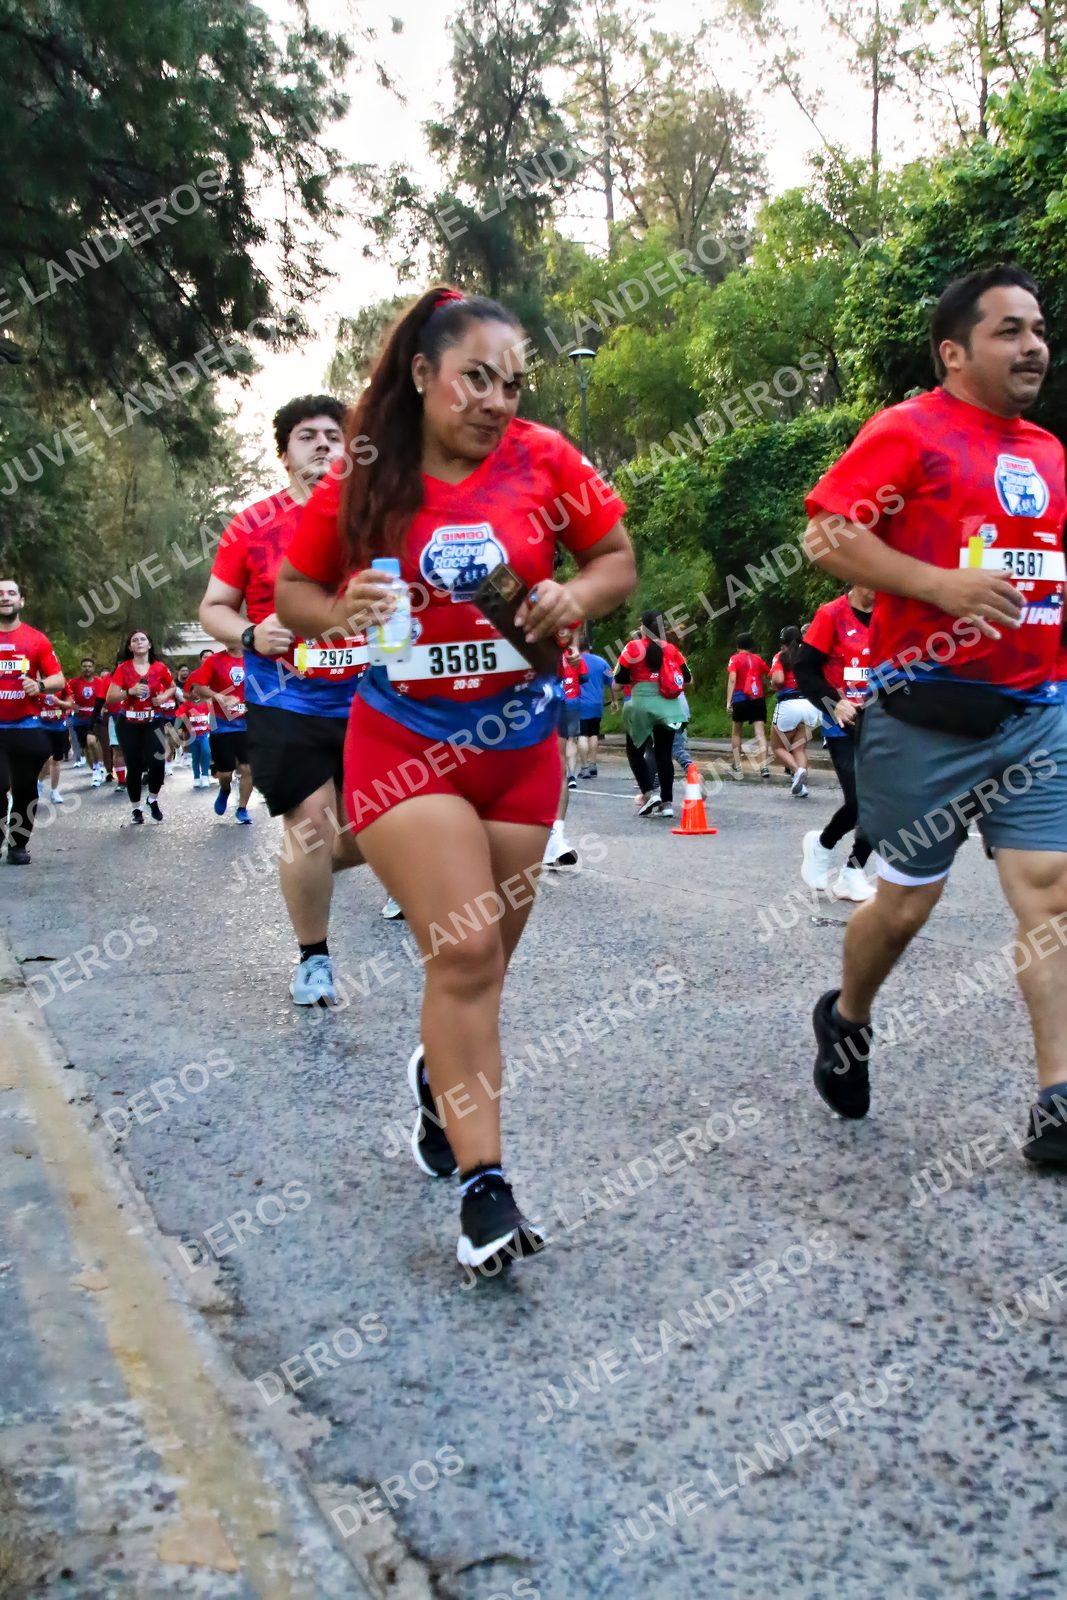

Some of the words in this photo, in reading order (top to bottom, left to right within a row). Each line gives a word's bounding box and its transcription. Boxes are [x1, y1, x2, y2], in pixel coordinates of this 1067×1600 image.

[440, 531, 485, 541] BIMBO
[441, 544, 486, 558] Global
[432, 556, 470, 569] Race
[1002, 551, 1044, 578] 3587
[319, 649, 353, 667] 2975
[428, 642, 497, 675] 3585
